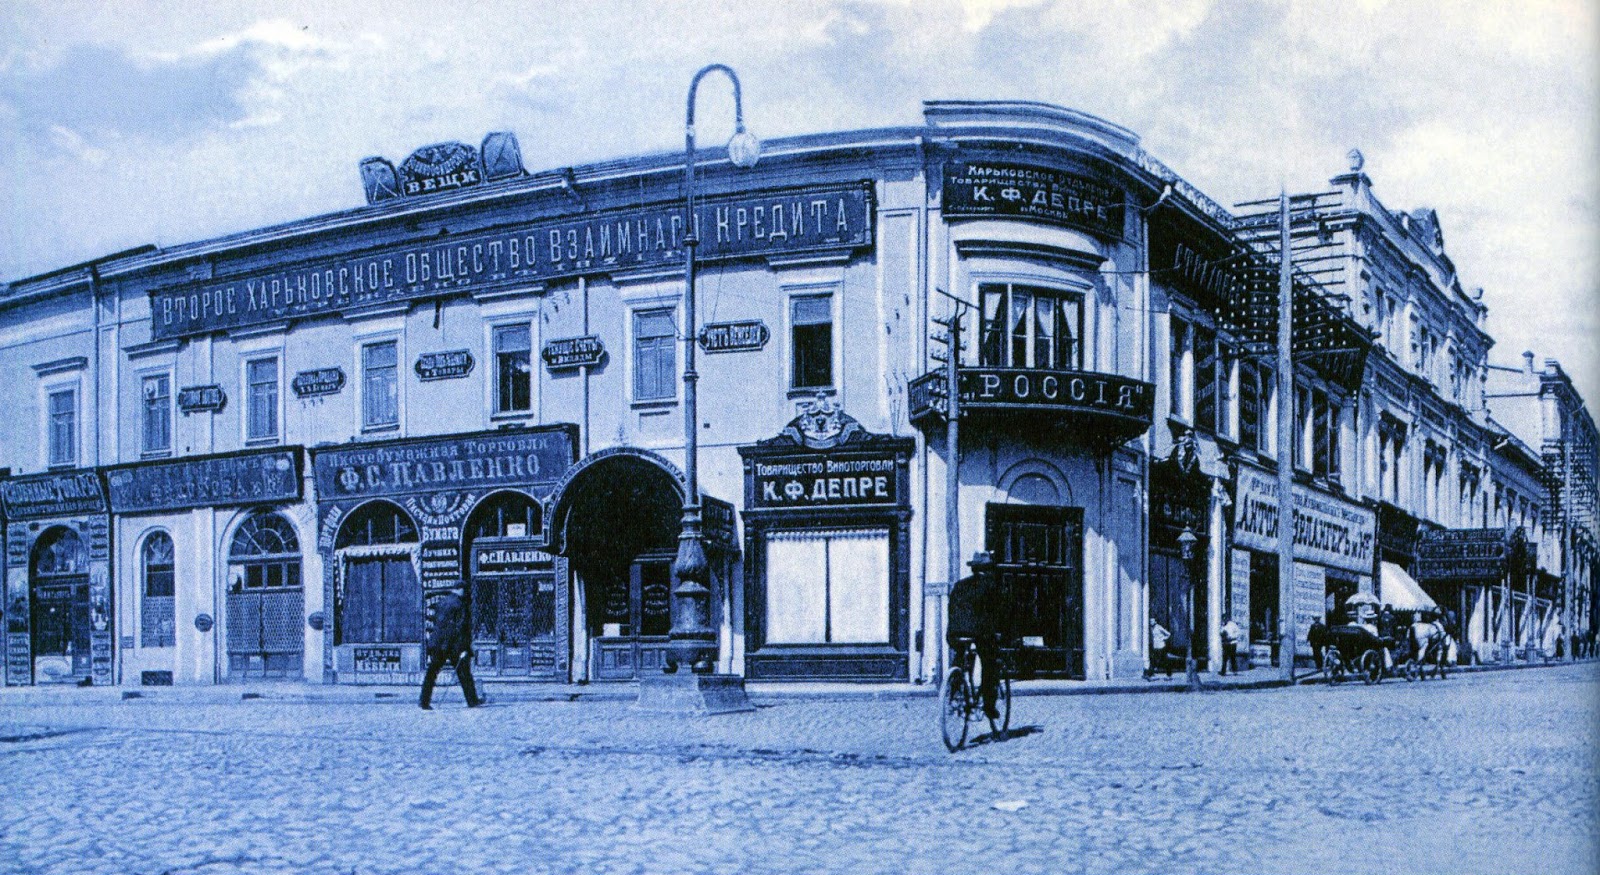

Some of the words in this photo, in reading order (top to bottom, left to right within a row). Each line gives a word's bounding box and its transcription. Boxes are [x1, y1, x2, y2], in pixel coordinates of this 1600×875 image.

[407, 170, 478, 194] ВЕЩИ
[1031, 189, 1108, 222] ДЕПРЕ
[163, 287, 236, 325] ВТОРОЕ
[247, 260, 393, 312] ХАРЬКОВСКОЕ
[406, 236, 537, 283] ОБЩЕСТВО
[716, 198, 849, 244] КРЕДИТА
[391, 453, 540, 488] ПАВЛЕНКО
[755, 462, 824, 477] ТОВАРИЩЕСТВО
[812, 476, 888, 501] ДЕПРЕ
